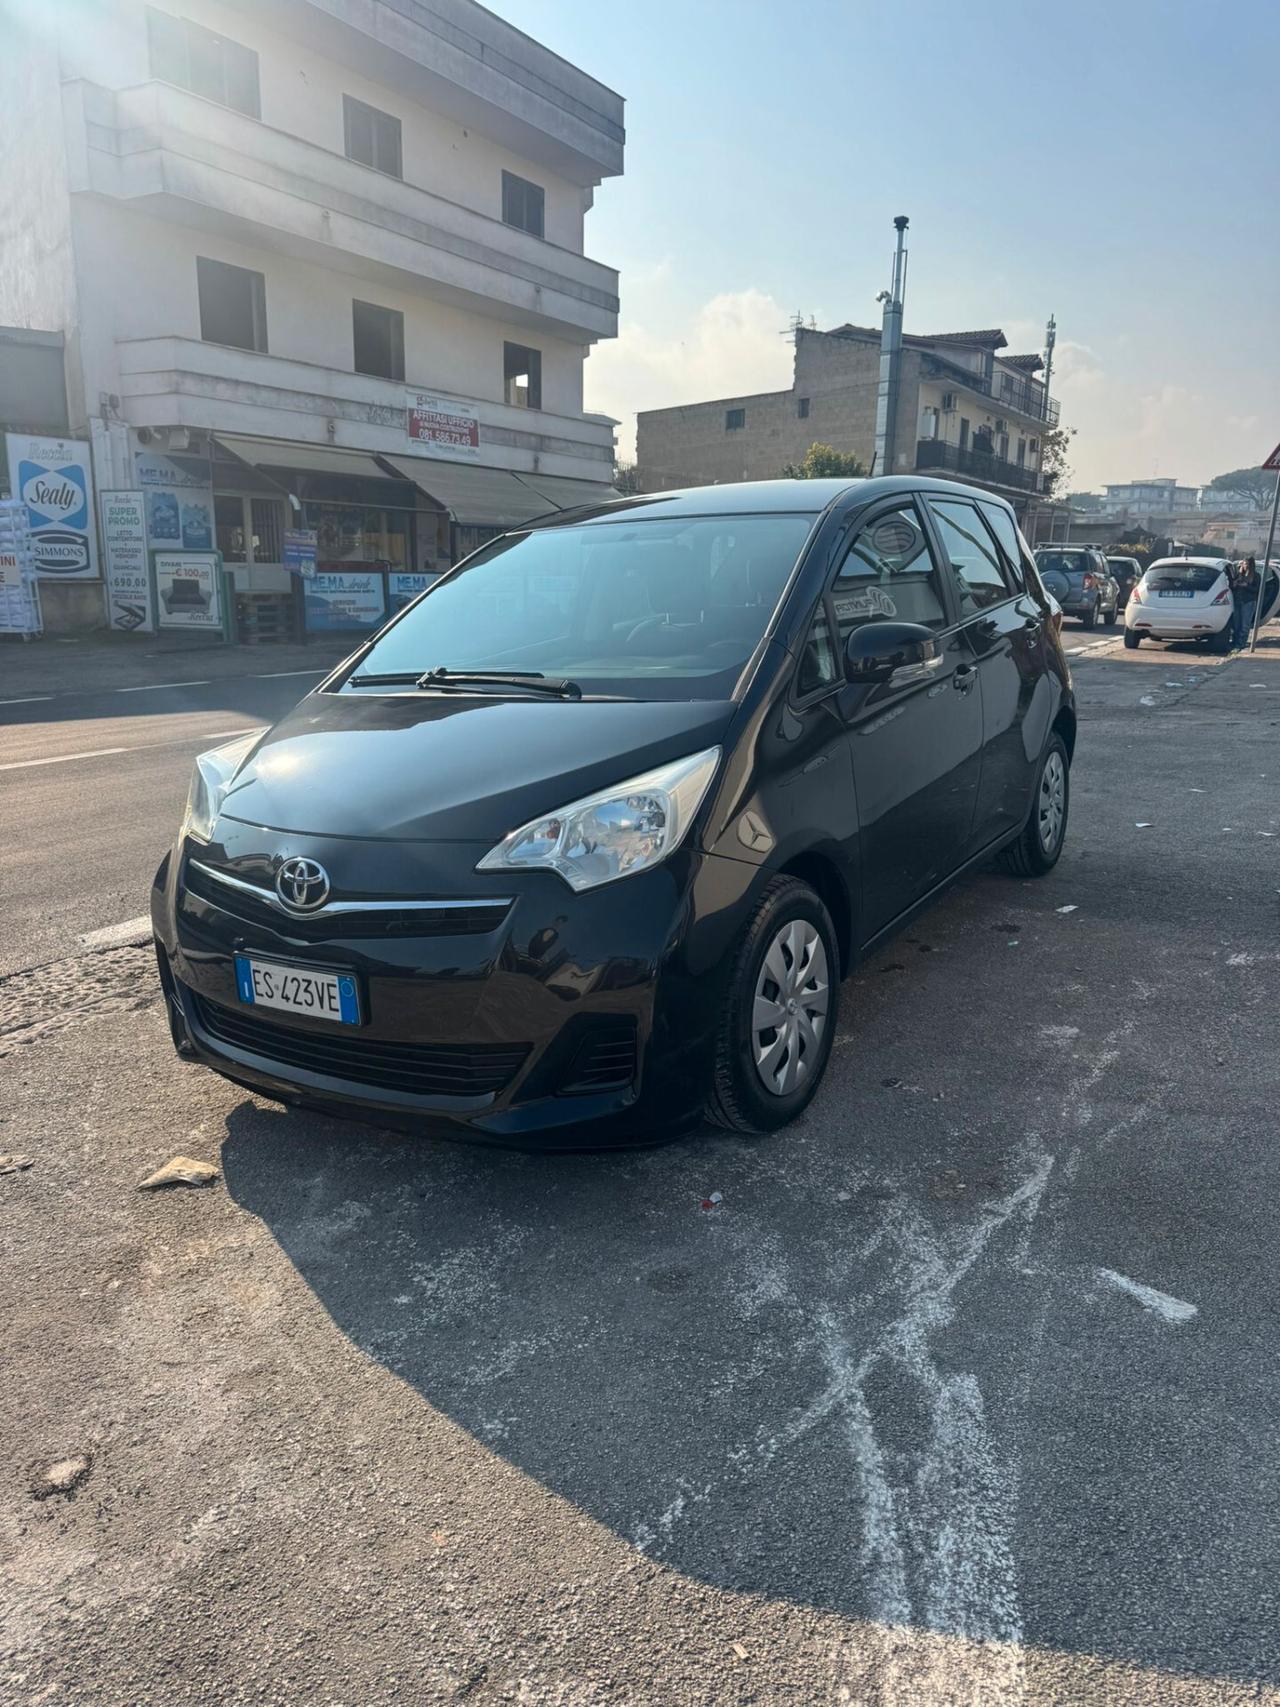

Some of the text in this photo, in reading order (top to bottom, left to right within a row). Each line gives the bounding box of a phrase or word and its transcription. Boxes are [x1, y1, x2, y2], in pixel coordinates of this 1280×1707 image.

[29, 480, 75, 511] Sealy
[109, 506, 137, 516] SUPER
[107, 516, 141, 525] PROMO
[34, 546, 84, 558] SIMMONS
[252, 968, 340, 1012] ES 423VE
